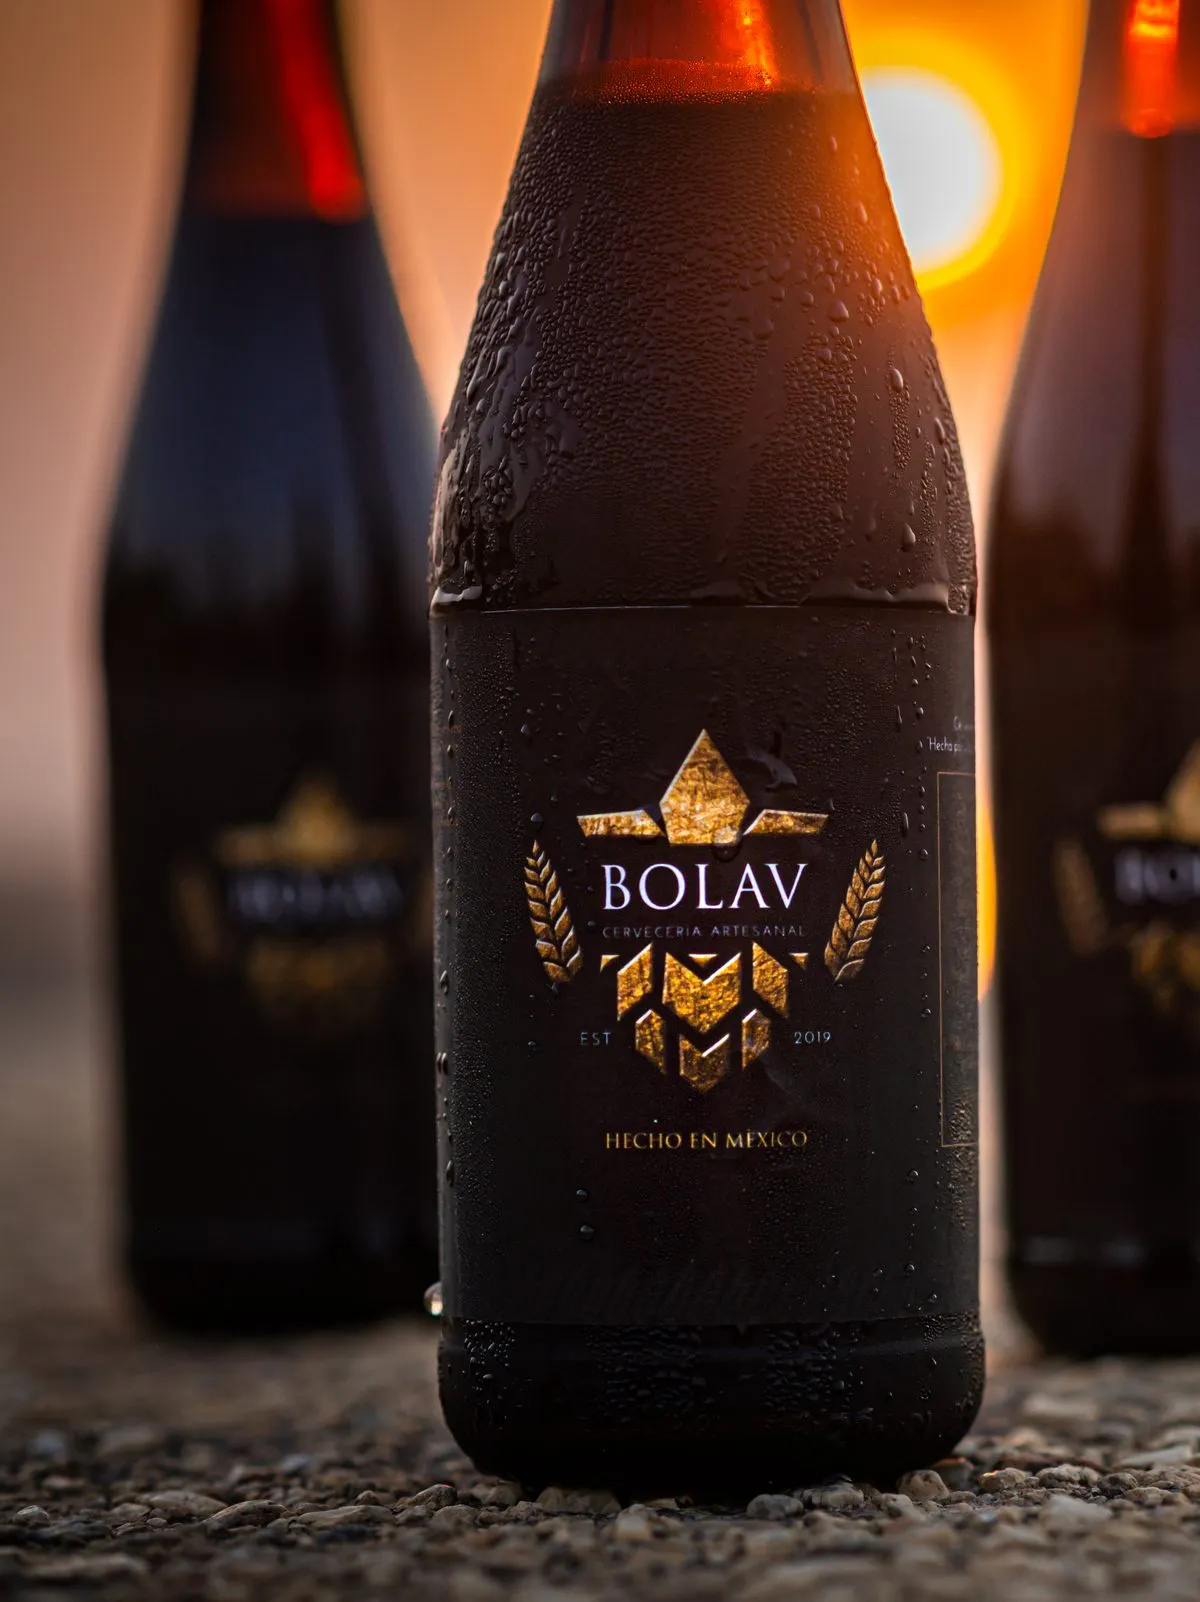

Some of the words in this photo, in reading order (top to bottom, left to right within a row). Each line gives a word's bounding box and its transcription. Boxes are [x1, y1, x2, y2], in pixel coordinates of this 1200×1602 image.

[601, 863, 808, 911] BOLAV
[602, 926, 702, 939] CERVECERIA
[711, 925, 807, 939] ARTESANAL
[580, 1032, 611, 1048] EST
[794, 1031, 832, 1045] 2019
[605, 1132, 683, 1149] HECHO
[690, 1132, 717, 1149] EN
